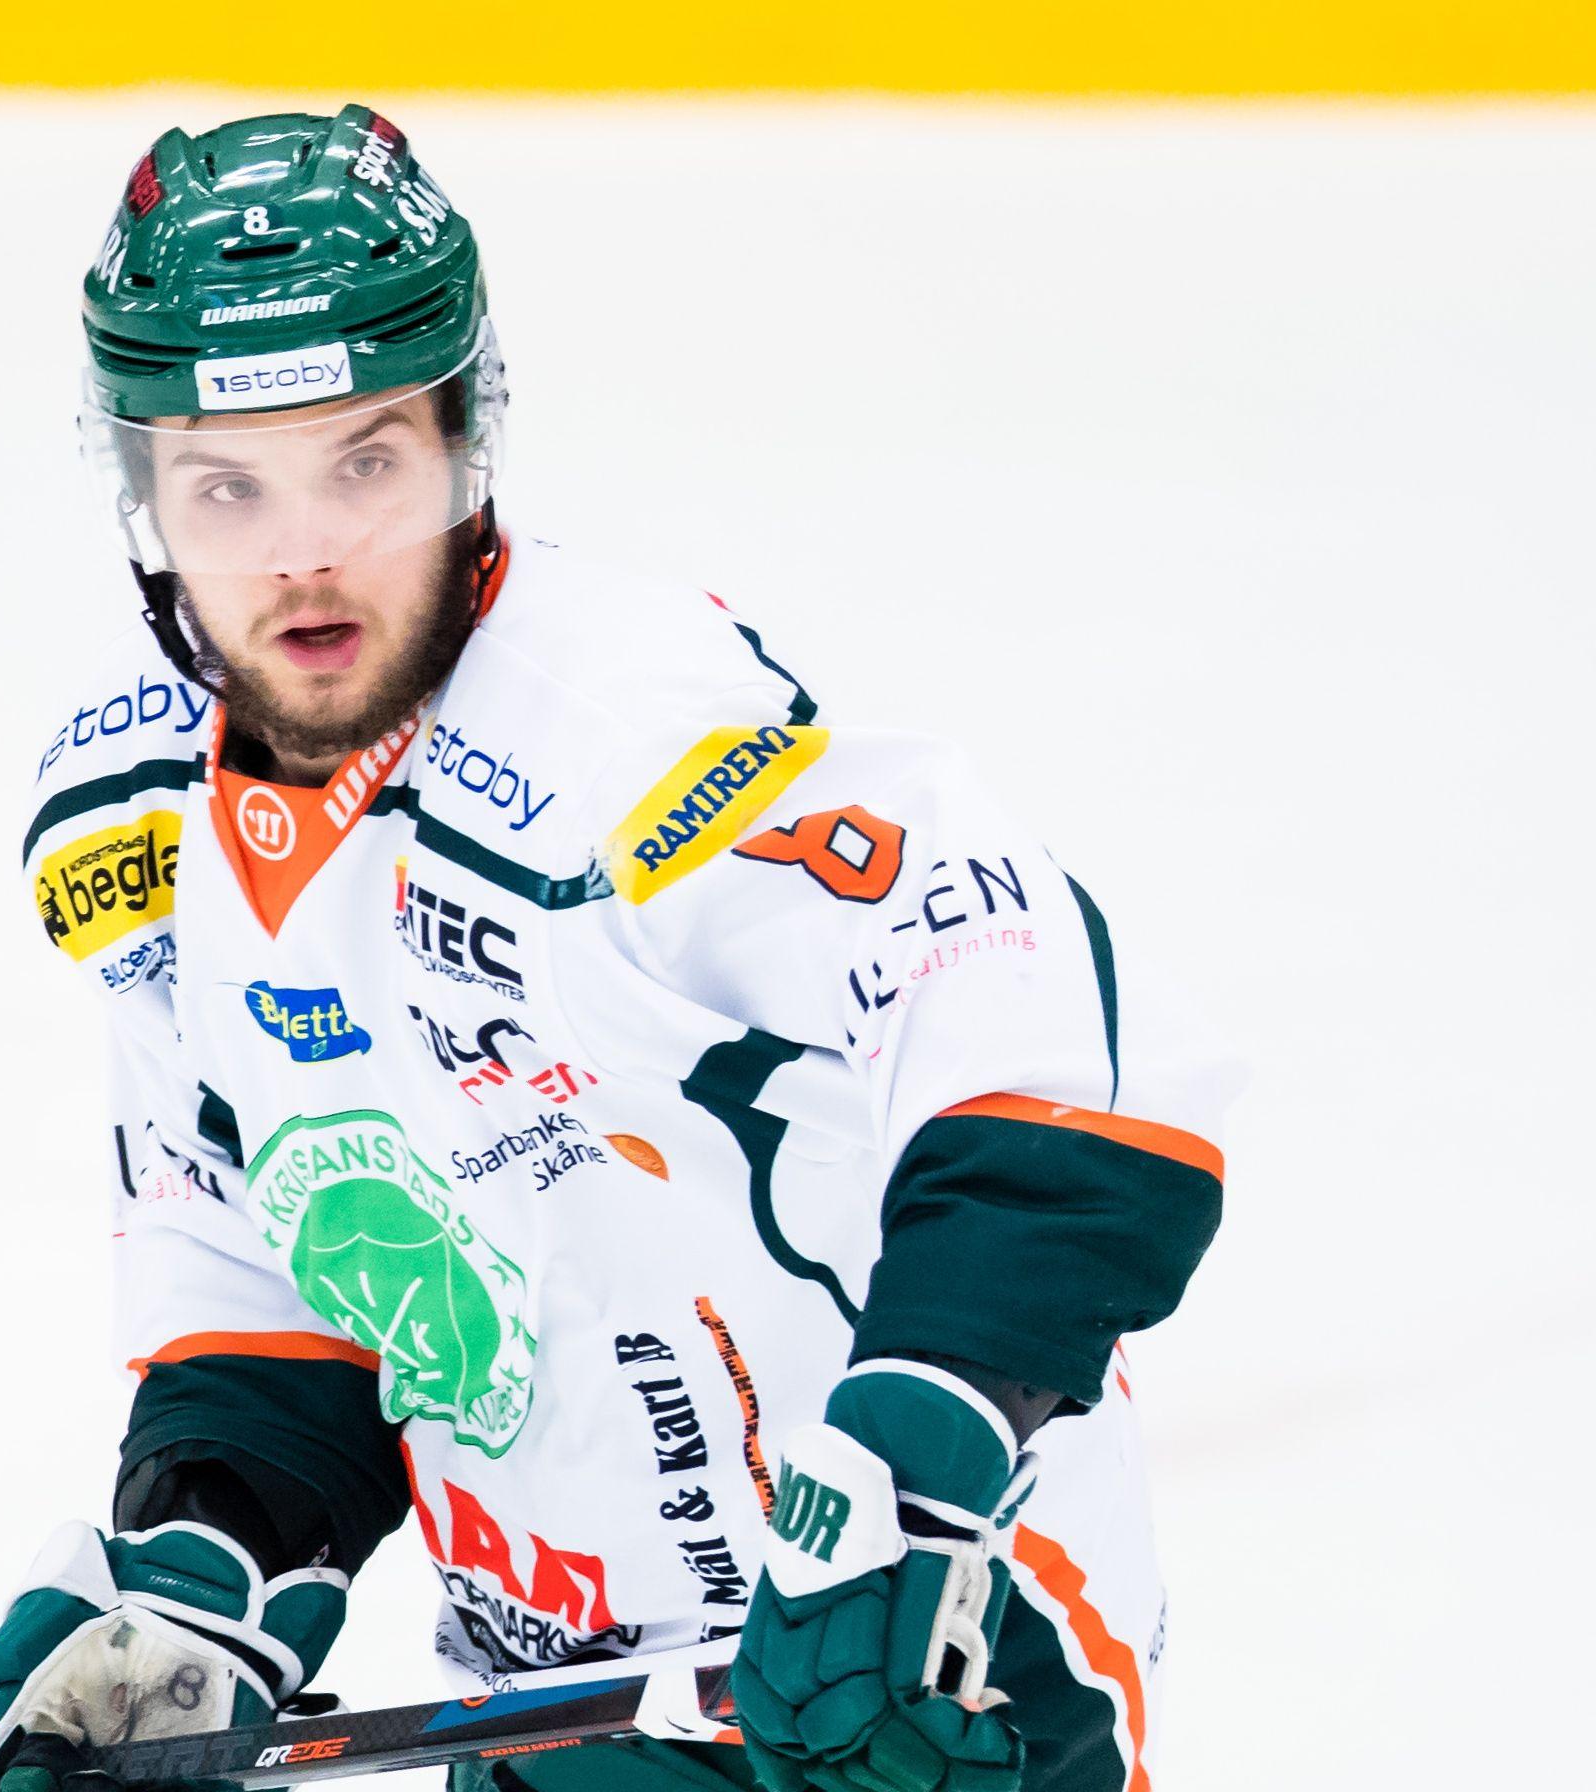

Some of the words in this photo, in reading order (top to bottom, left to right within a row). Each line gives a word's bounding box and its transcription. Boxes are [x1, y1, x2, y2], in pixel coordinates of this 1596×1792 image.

[243, 206, 270, 235] 8
[200, 295, 332, 326] WARRIOR
[230, 359, 346, 393] stoby
[46, 674, 210, 768] stoby
[427, 724, 555, 831] stoby
[532, 1140, 607, 1191] Skåne
[631, 1376, 708, 1475] Kart
[660, 1485, 715, 1522] &
[678, 1535, 749, 1606] Mät
